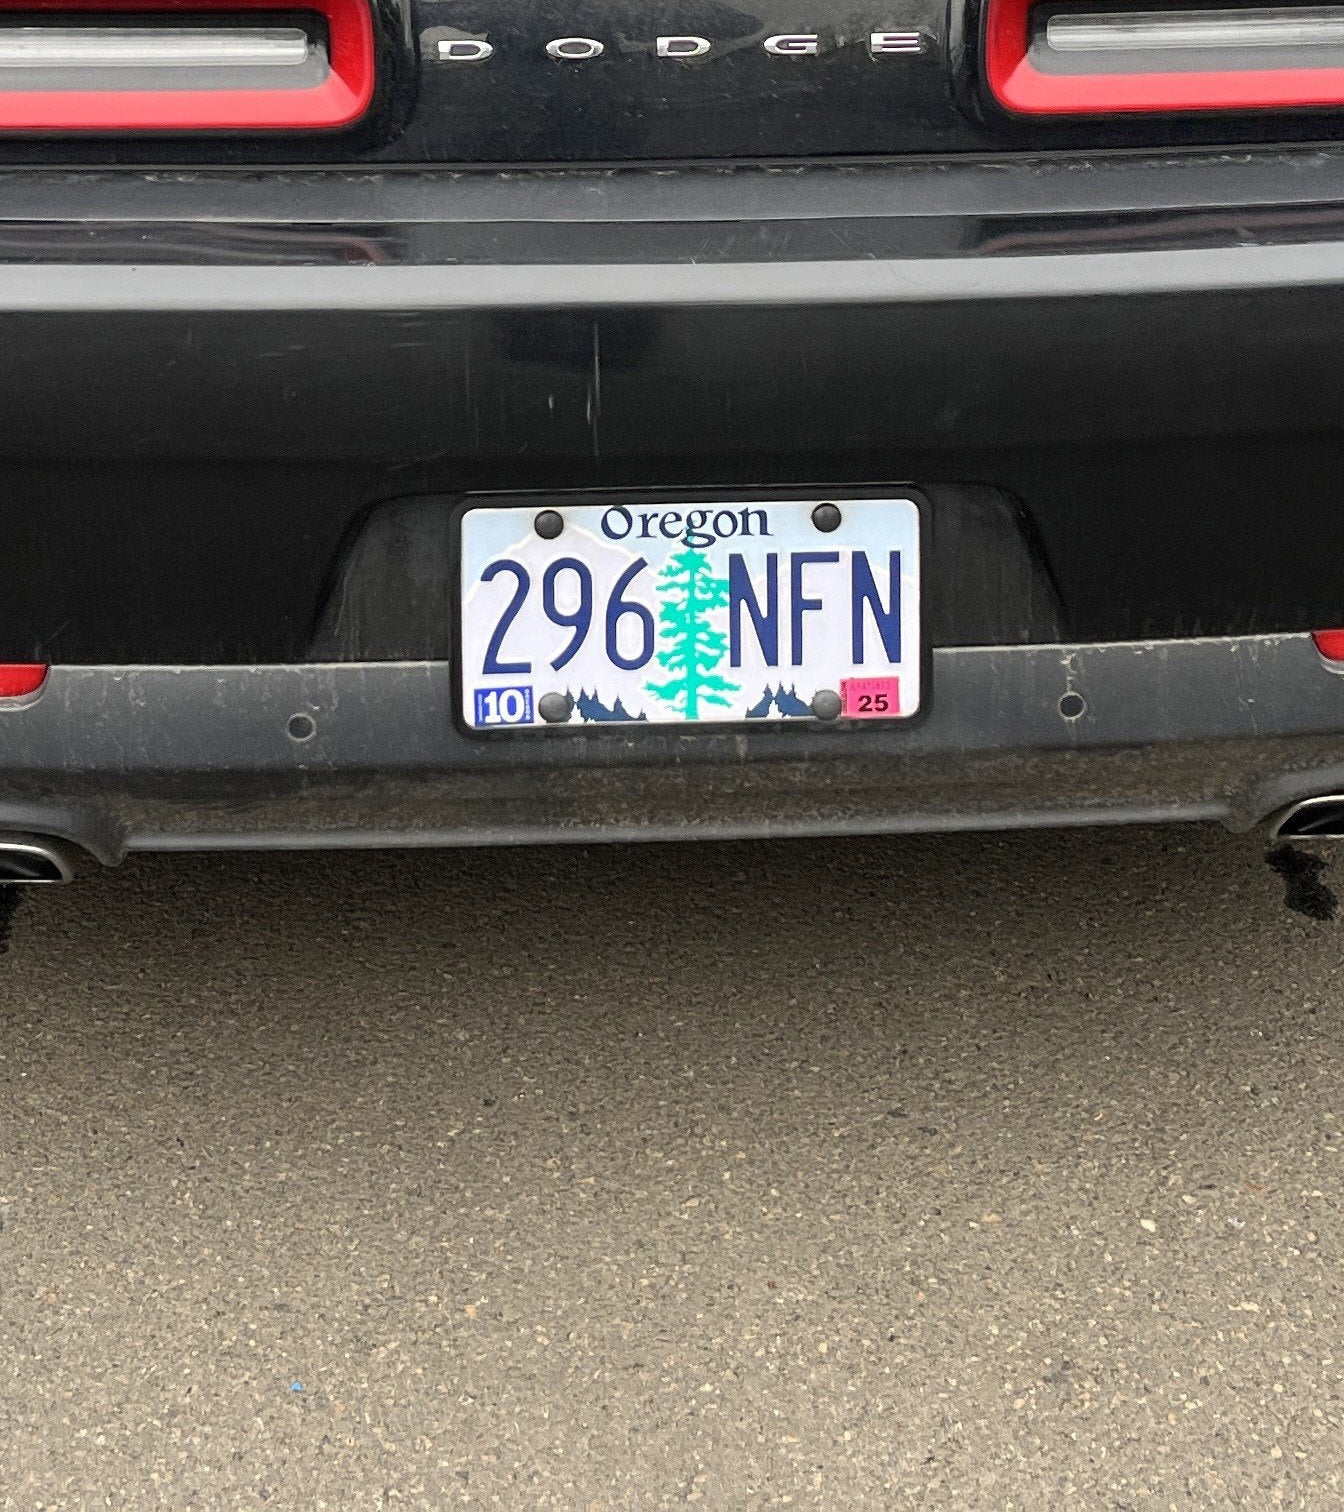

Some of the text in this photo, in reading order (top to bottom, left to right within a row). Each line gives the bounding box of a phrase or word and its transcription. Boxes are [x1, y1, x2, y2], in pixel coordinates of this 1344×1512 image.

[437, 31, 922, 61] DODGE
[600, 505, 774, 549] Oregon
[478, 550, 902, 675] 296 NFN
[484, 689, 525, 724] 10
[857, 693, 889, 712] 25
